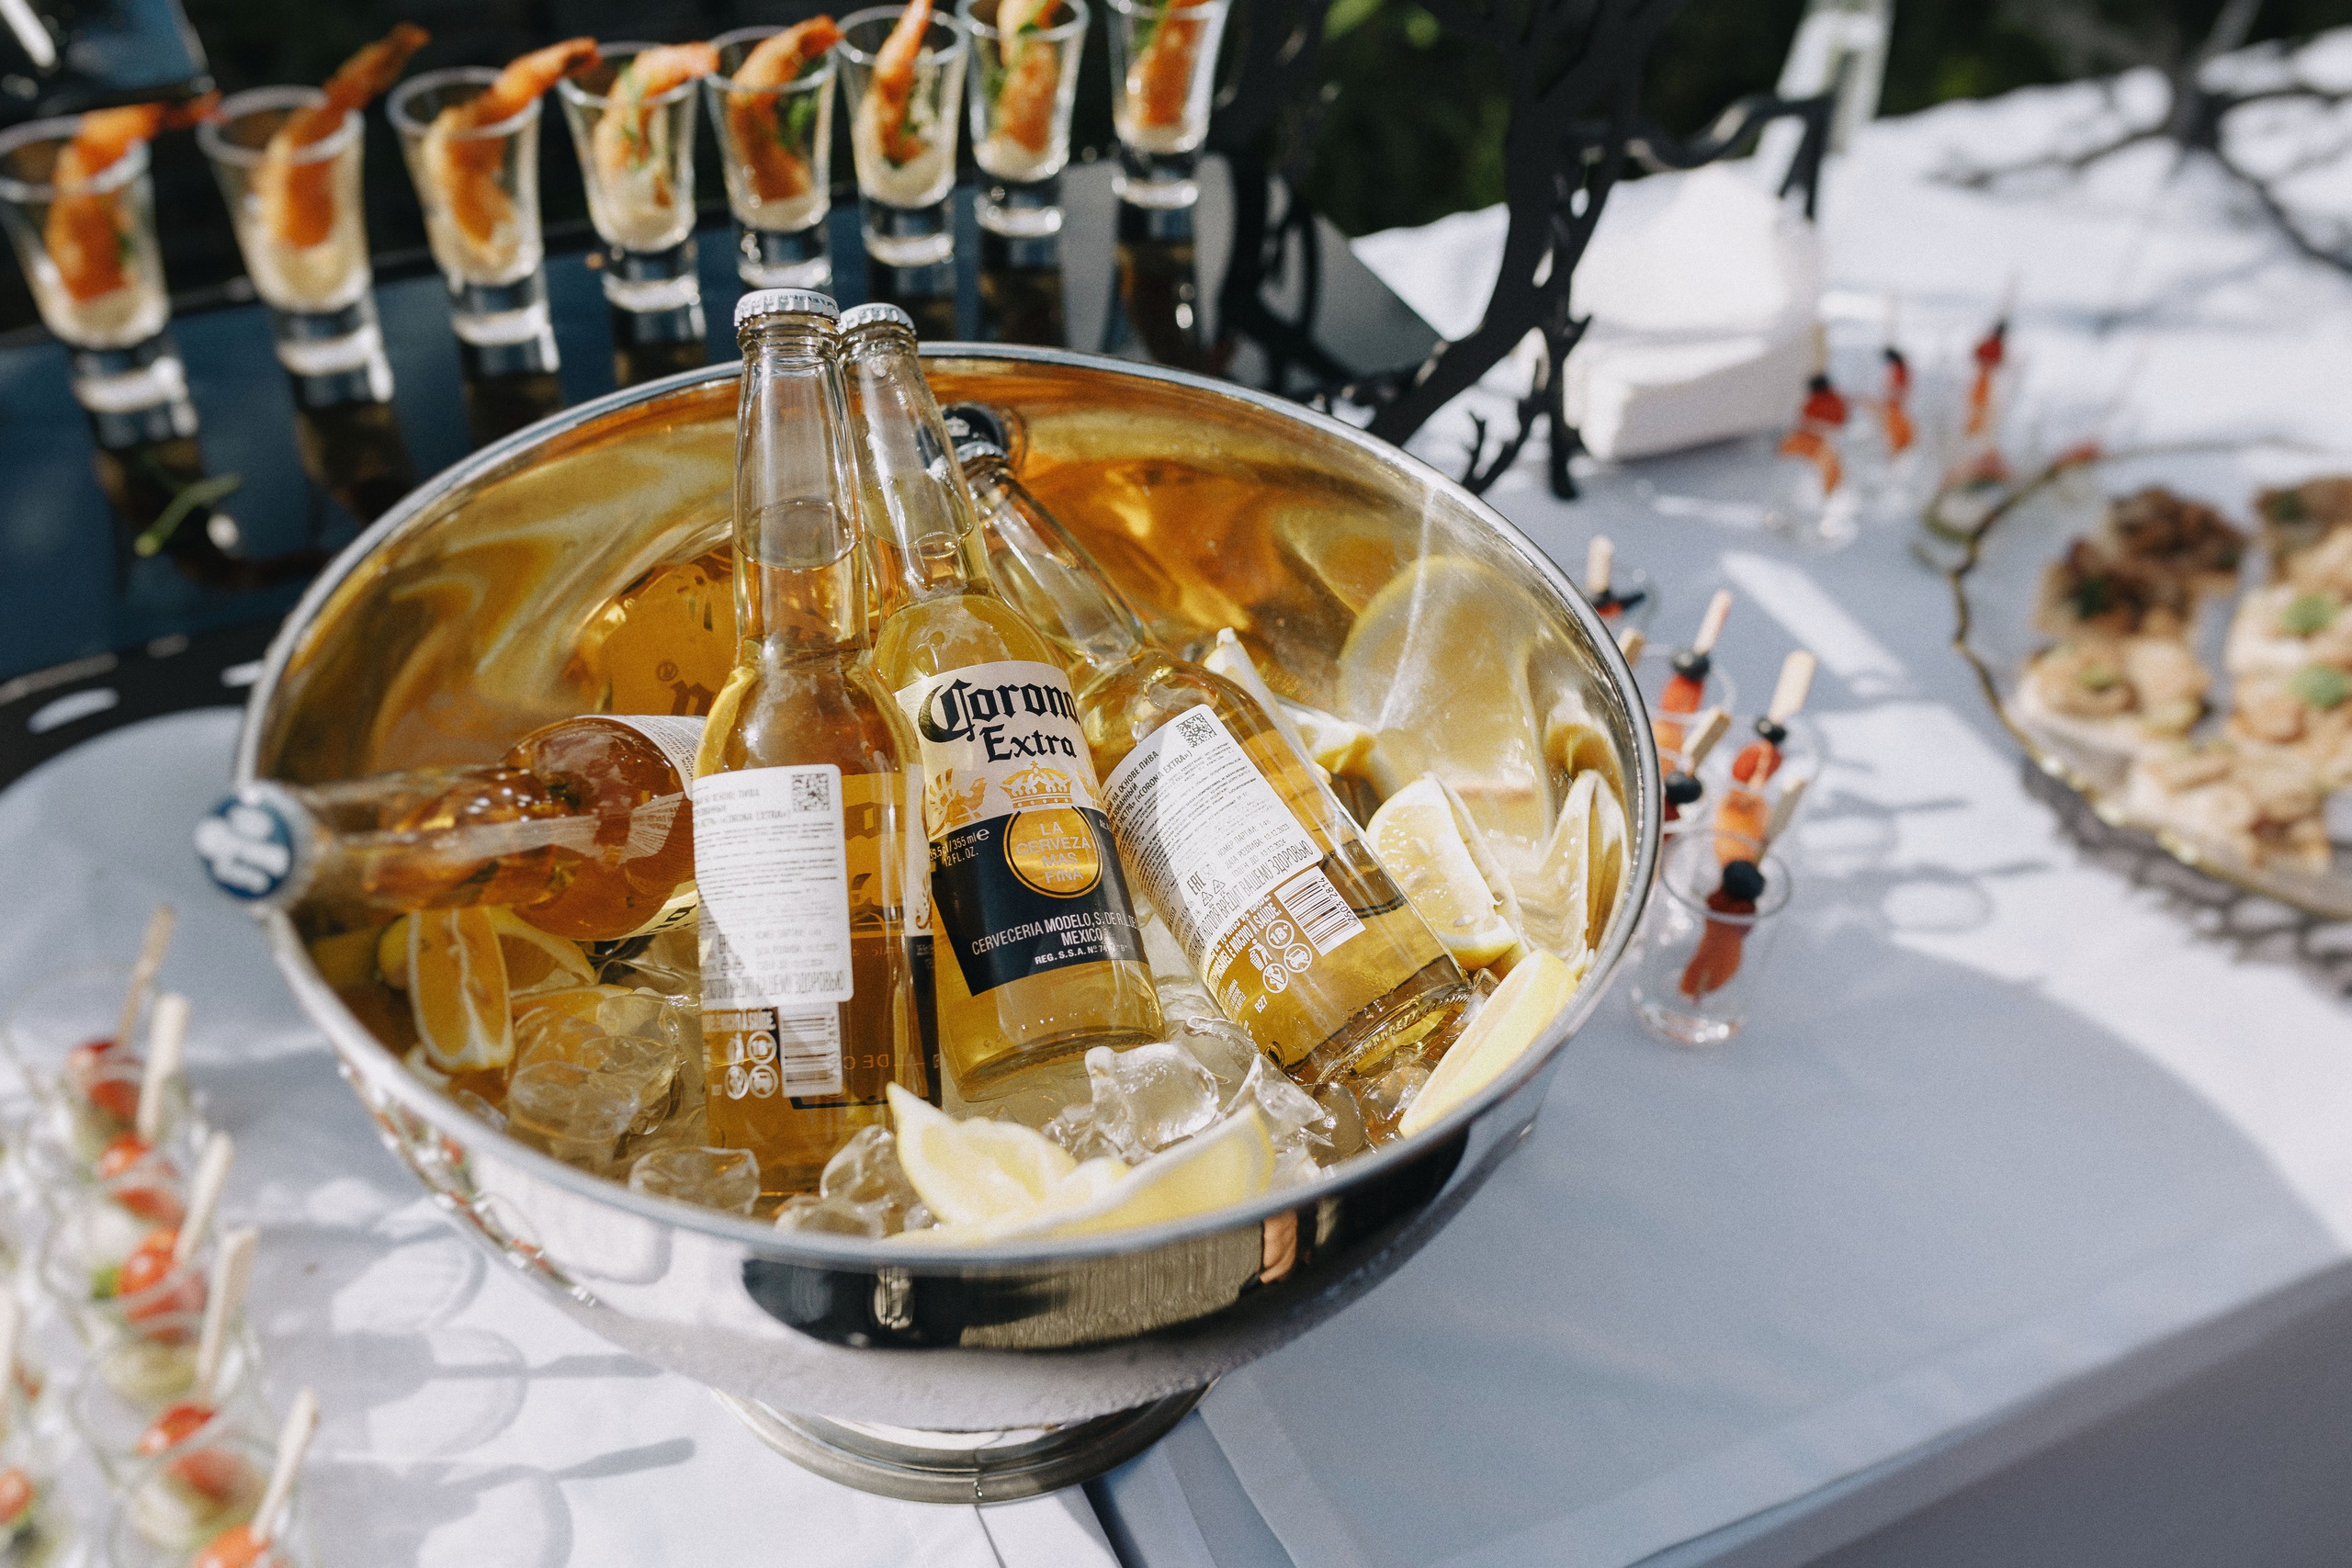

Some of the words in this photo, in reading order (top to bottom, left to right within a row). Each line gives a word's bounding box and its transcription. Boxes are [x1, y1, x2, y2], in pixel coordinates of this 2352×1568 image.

[919, 678, 1080, 743] Corona
[980, 723, 1077, 763] Extra
[1162, 749, 1193, 773] EXTRA»)
[1111, 791, 1119, 804] НА
[1118, 766, 1140, 793] ОСНОВЕ
[1138, 750, 1159, 770] ПИВА
[1040, 821, 1064, 837] LA
[1216, 839, 1235, 857] НОМЕР
[1234, 824, 1259, 844] ПАРТИИ:
[944, 855, 952, 867] 12
[965, 846, 978, 859] OZ.
[1015, 836, 1091, 856] CERVEZA
[1224, 854, 1238, 869] ДАТА
[1238, 837, 1263, 857] РОЗЛИВА:
[1041, 852, 1079, 868] MAS
[1231, 862, 1249, 878] ГОДЕН
[1044, 868, 1084, 885] FINA
[1215, 884, 1245, 918] ВРЕДИТ
[1238, 862, 1274, 897] ВАШЕМУ
[1267, 839, 1314, 874] ЗДОРОВЬЮ
[971, 920, 1044, 956] CERVECERIA
[1045, 912, 1095, 938] MODELO,
[1104, 911, 1117, 925] DE
[1228, 923, 1254, 953] NOCIVO
[1252, 902, 1283, 930] SAÚDE.
[1269, 922, 1289, 945] 18+
[1034, 953, 1057, 965] REG.
[1059, 946, 1087, 960] S.S.A.
[1254, 993, 1269, 1014] B27
